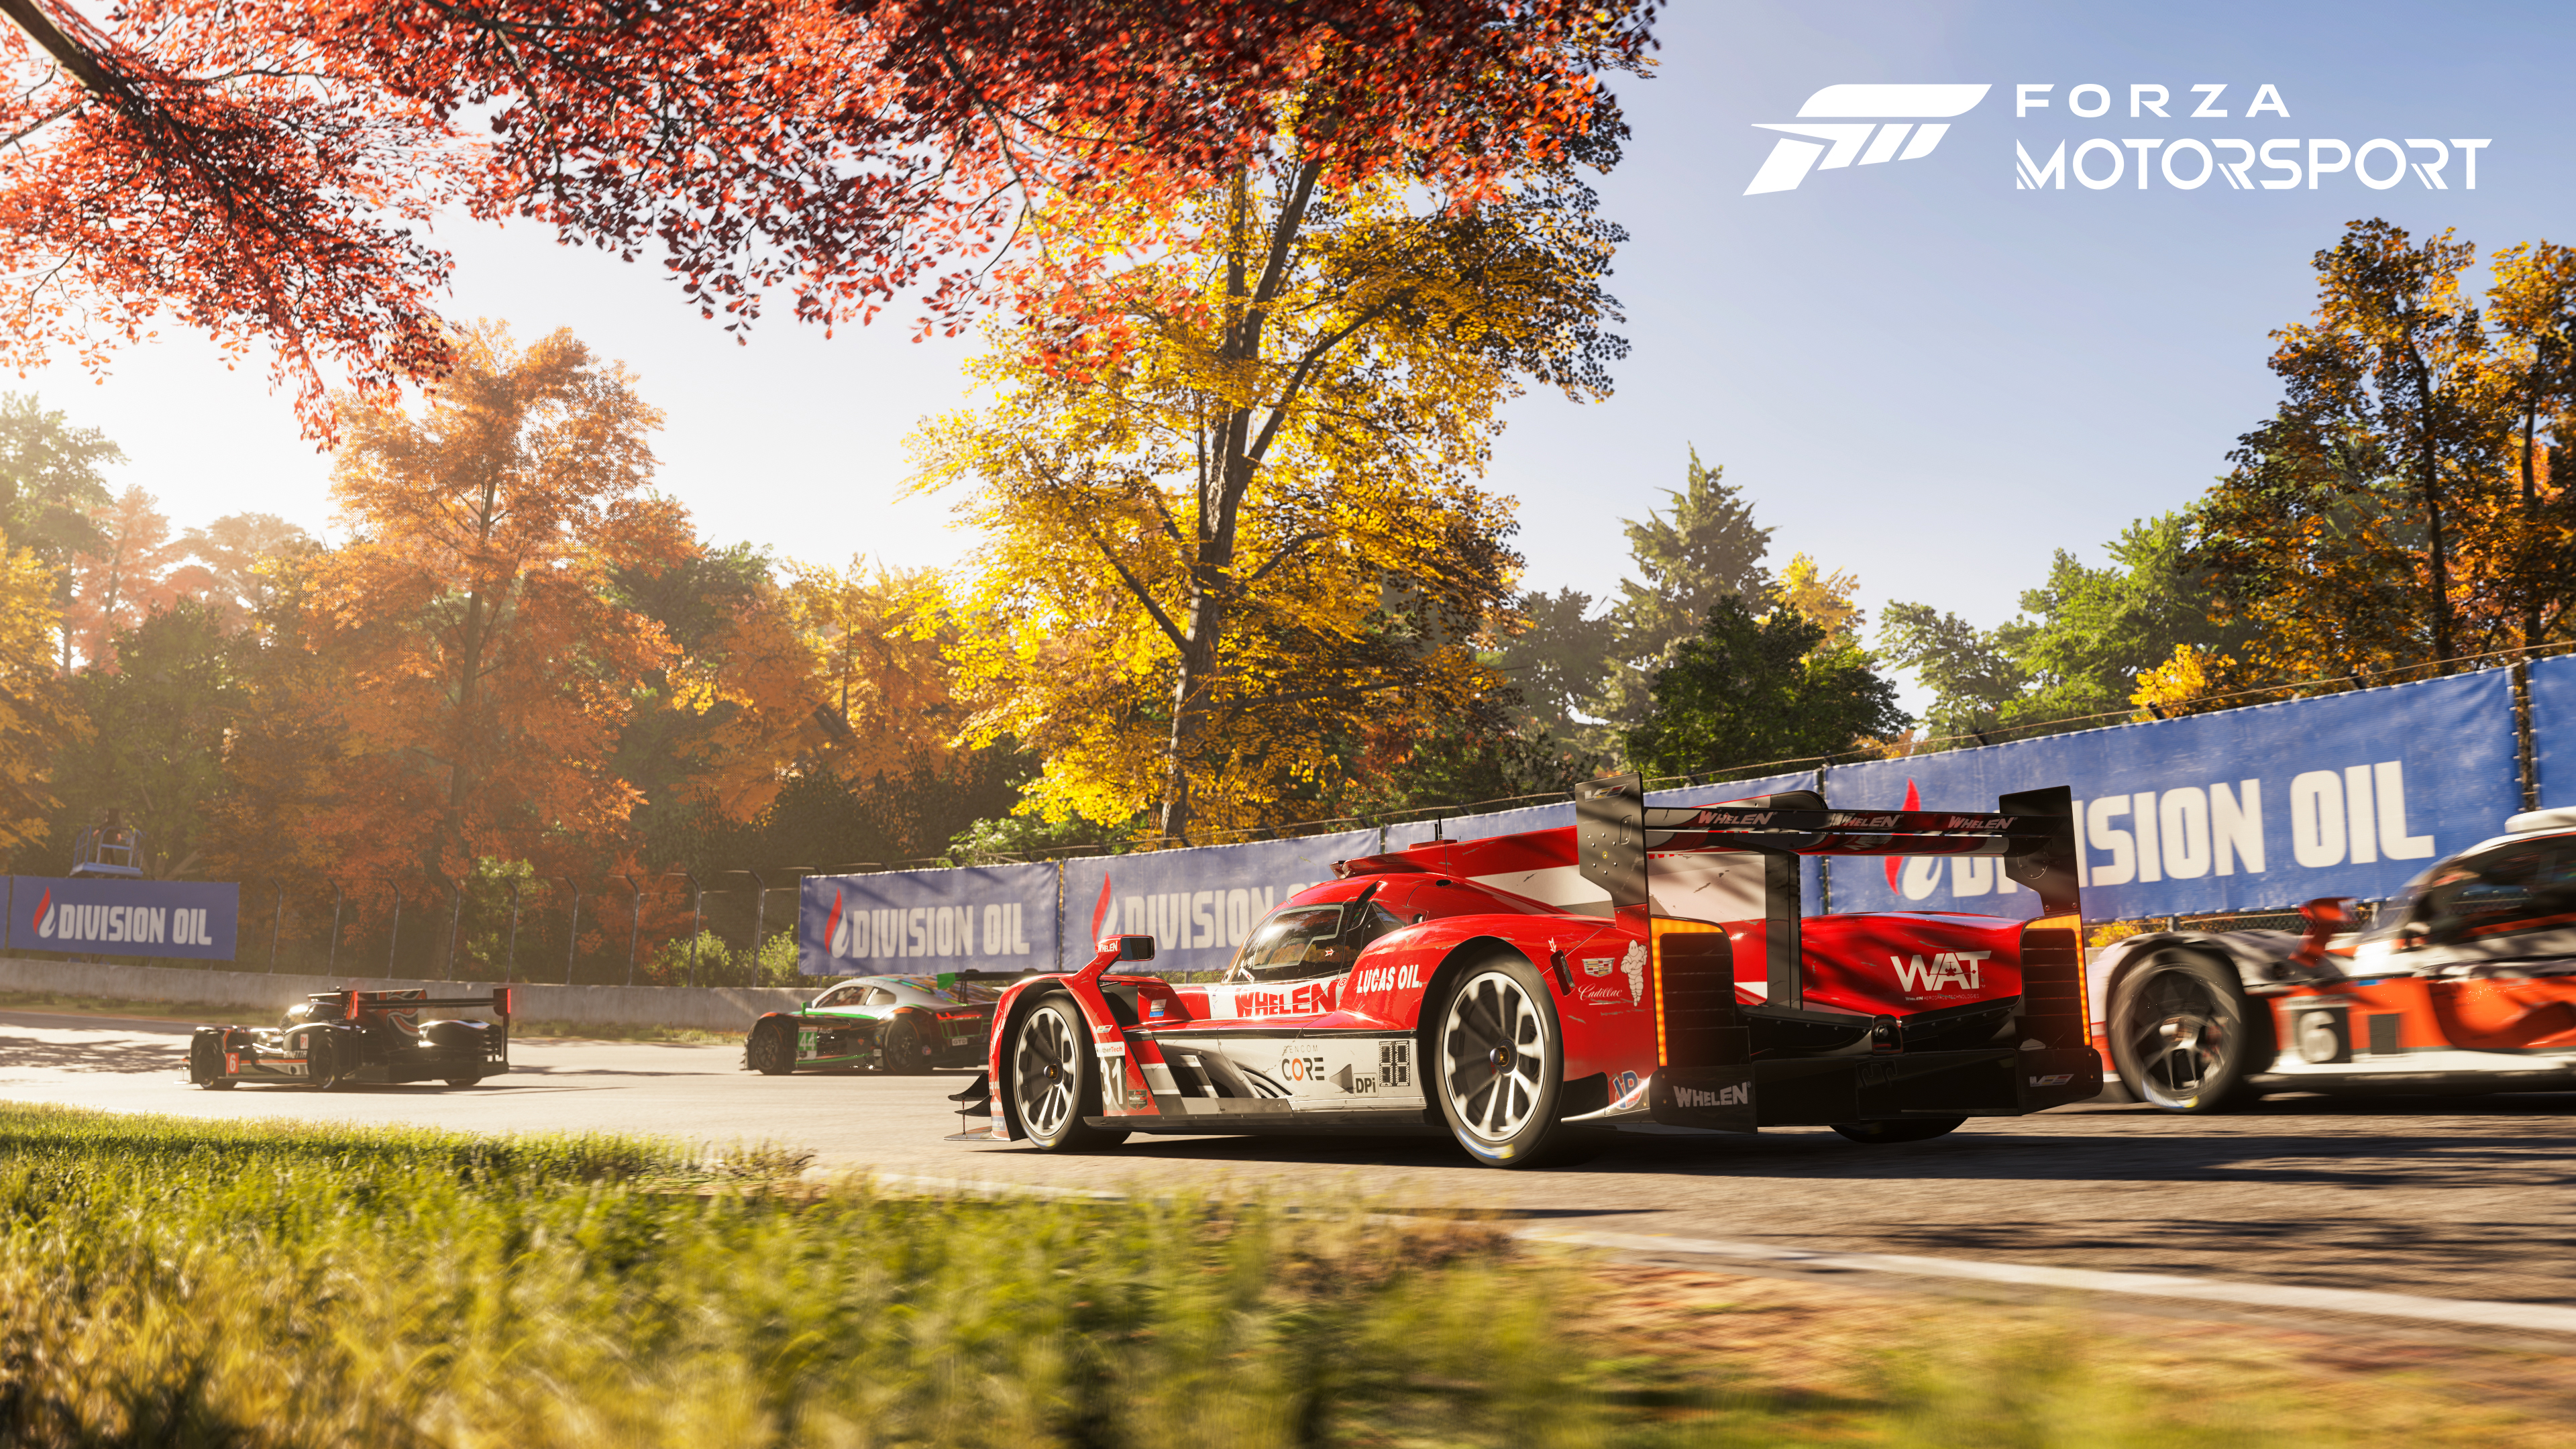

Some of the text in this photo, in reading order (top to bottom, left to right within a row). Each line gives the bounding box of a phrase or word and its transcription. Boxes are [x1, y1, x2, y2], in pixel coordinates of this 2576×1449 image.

[2290, 760, 2435, 868] OIL
[58, 904, 212, 945] DIVISION OIL
[853, 903, 1030, 958] DIVISION OIL
[1097, 941, 1118, 953] WHELEN
[1356, 966, 1396, 994] LUCAS
[1890, 951, 1992, 991] WAT
[1578, 983, 1623, 1001] Cadillac
[301, 1036, 307, 1044] P1
[799, 1032, 816, 1050] 44
[229, 1054, 236, 1072] 6
[1281, 1057, 1325, 1081] CORE
[1100, 1058, 1124, 1106] 31
[1356, 1077, 1376, 1093] DPi
